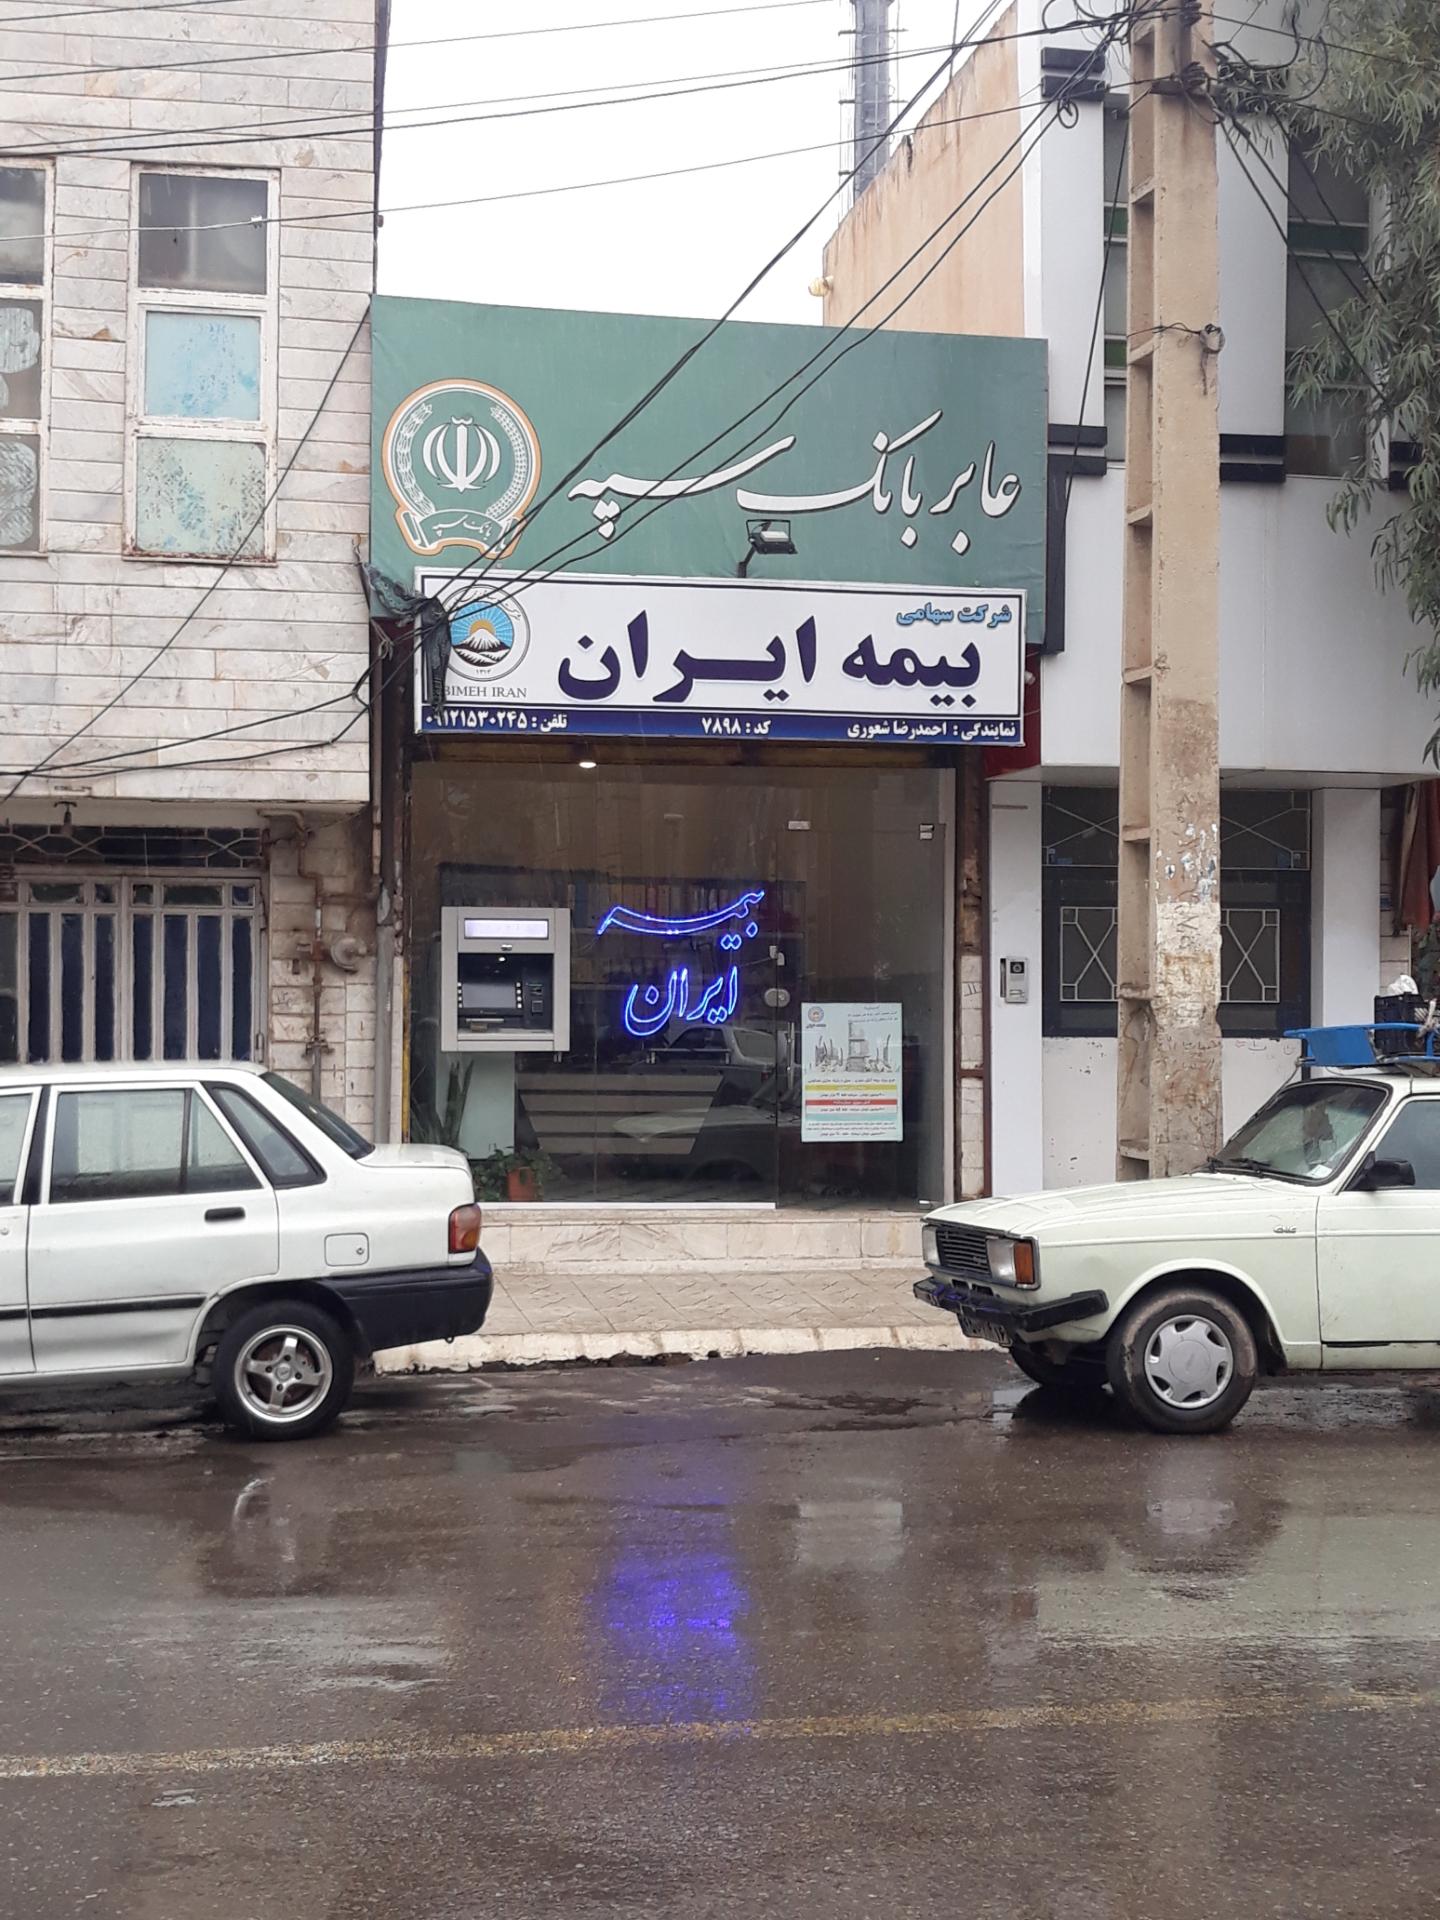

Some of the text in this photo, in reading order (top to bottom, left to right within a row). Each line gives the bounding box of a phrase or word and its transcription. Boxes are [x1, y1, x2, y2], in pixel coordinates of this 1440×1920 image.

[567, 408, 1022, 556] عابر بانک سپه
[895, 602, 1012, 628] شرکت سهامی
[557, 608, 981, 709] بیمه ایران
[444, 685, 527, 699] BIMEH IRAN
[701, 717, 742, 735] ۷۸۹۸
[847, 720, 891, 739] شعوری
[597, 890, 765, 951] بیمه
[624, 964, 739, 1037] ایران
